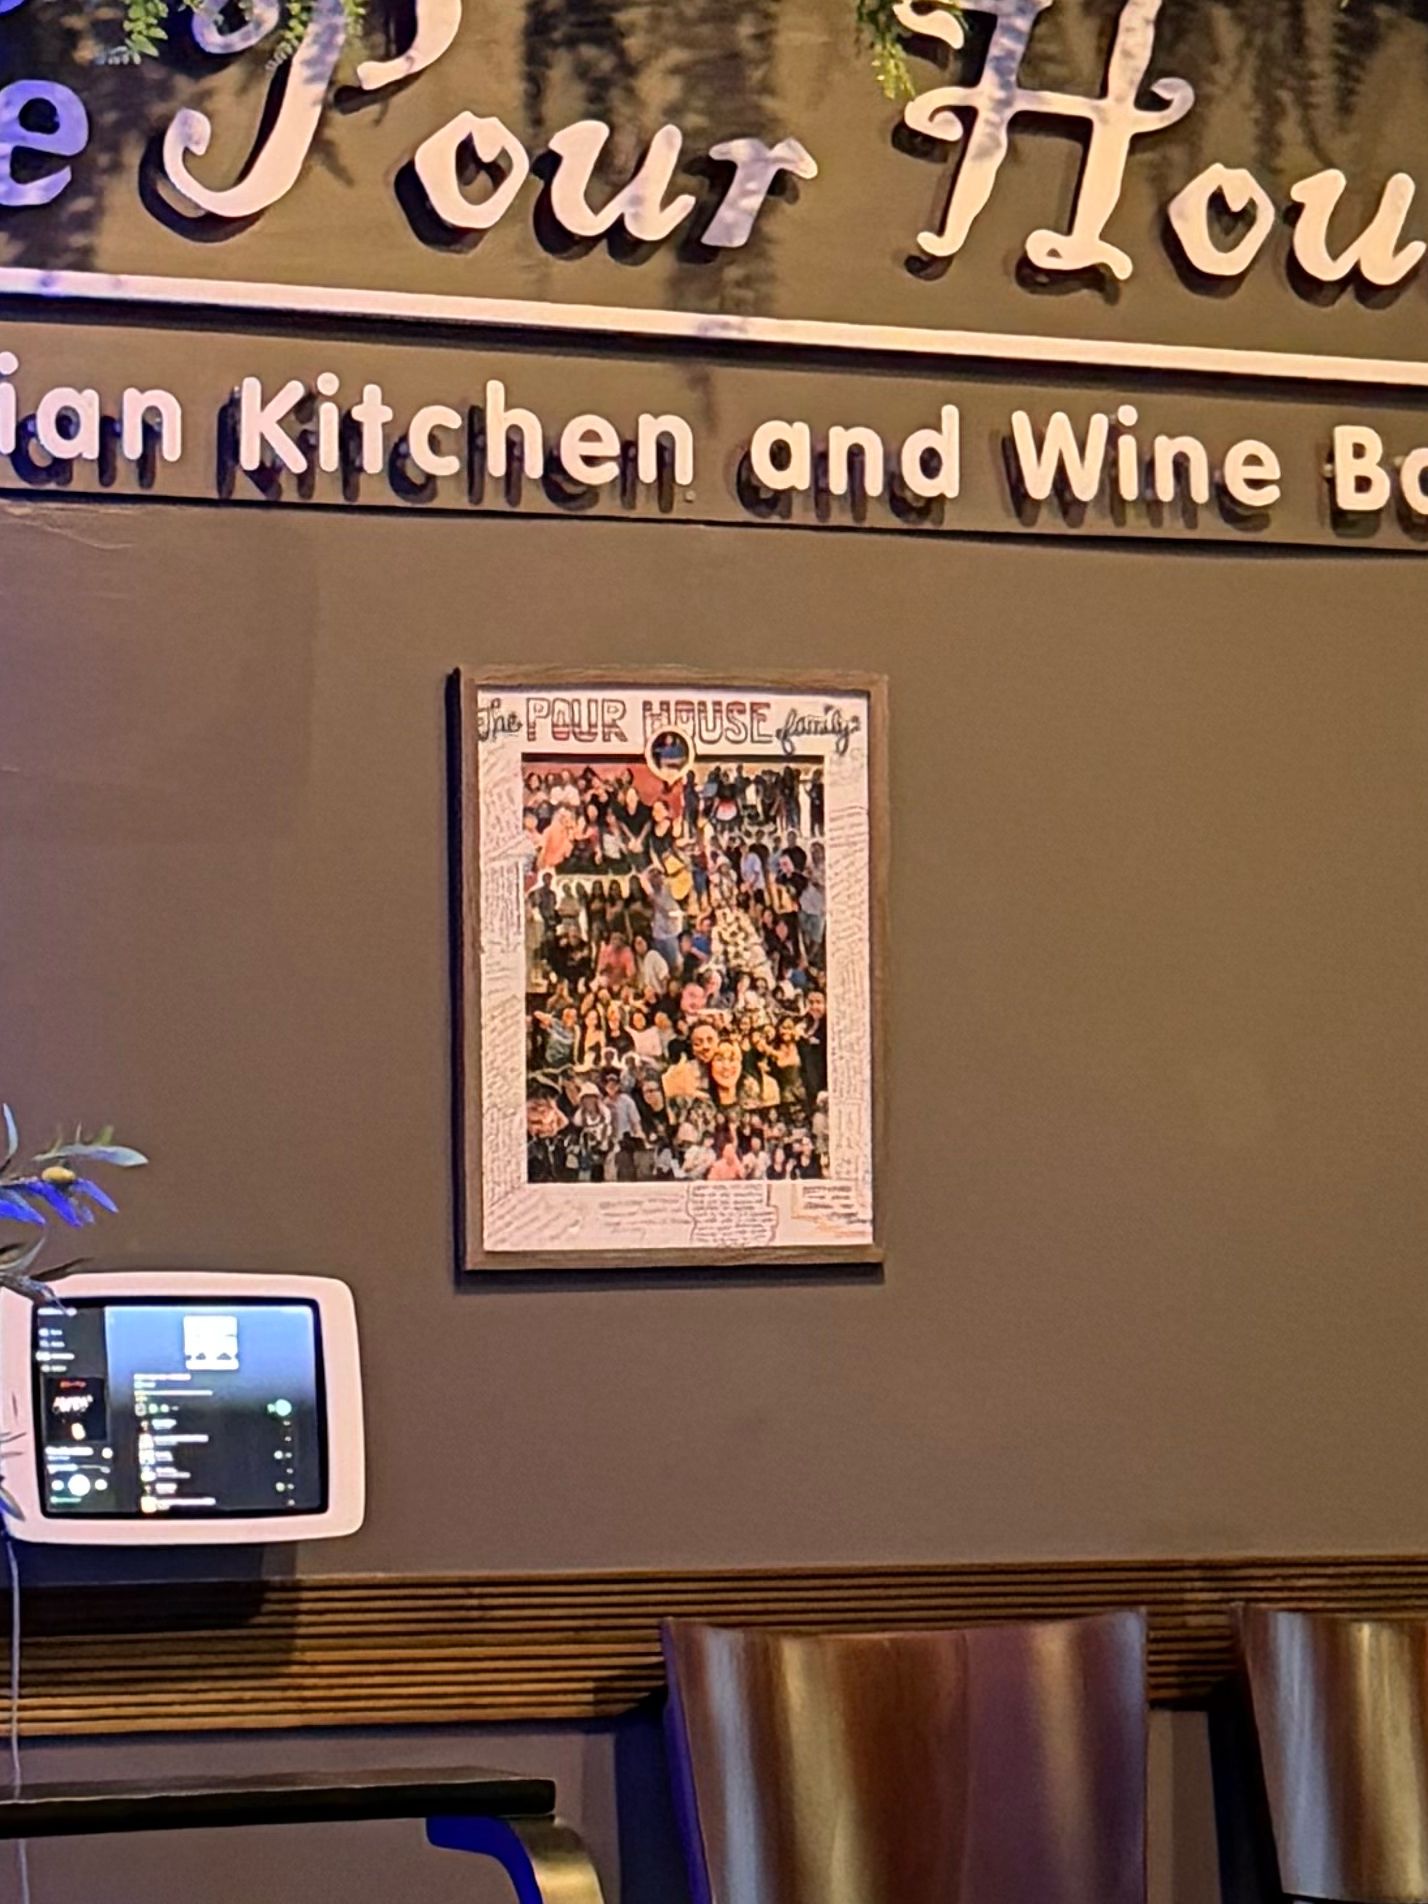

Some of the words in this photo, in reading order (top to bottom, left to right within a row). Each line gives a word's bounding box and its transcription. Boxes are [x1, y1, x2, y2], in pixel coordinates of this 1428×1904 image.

[239, 372, 694, 486] Kitchen
[750, 403, 960, 498] and
[1011, 405, 1281, 506] Wine
[478, 698, 523, 742] The
[525, 697, 628, 743] POUR
[642, 700, 774, 745] HOUSE
